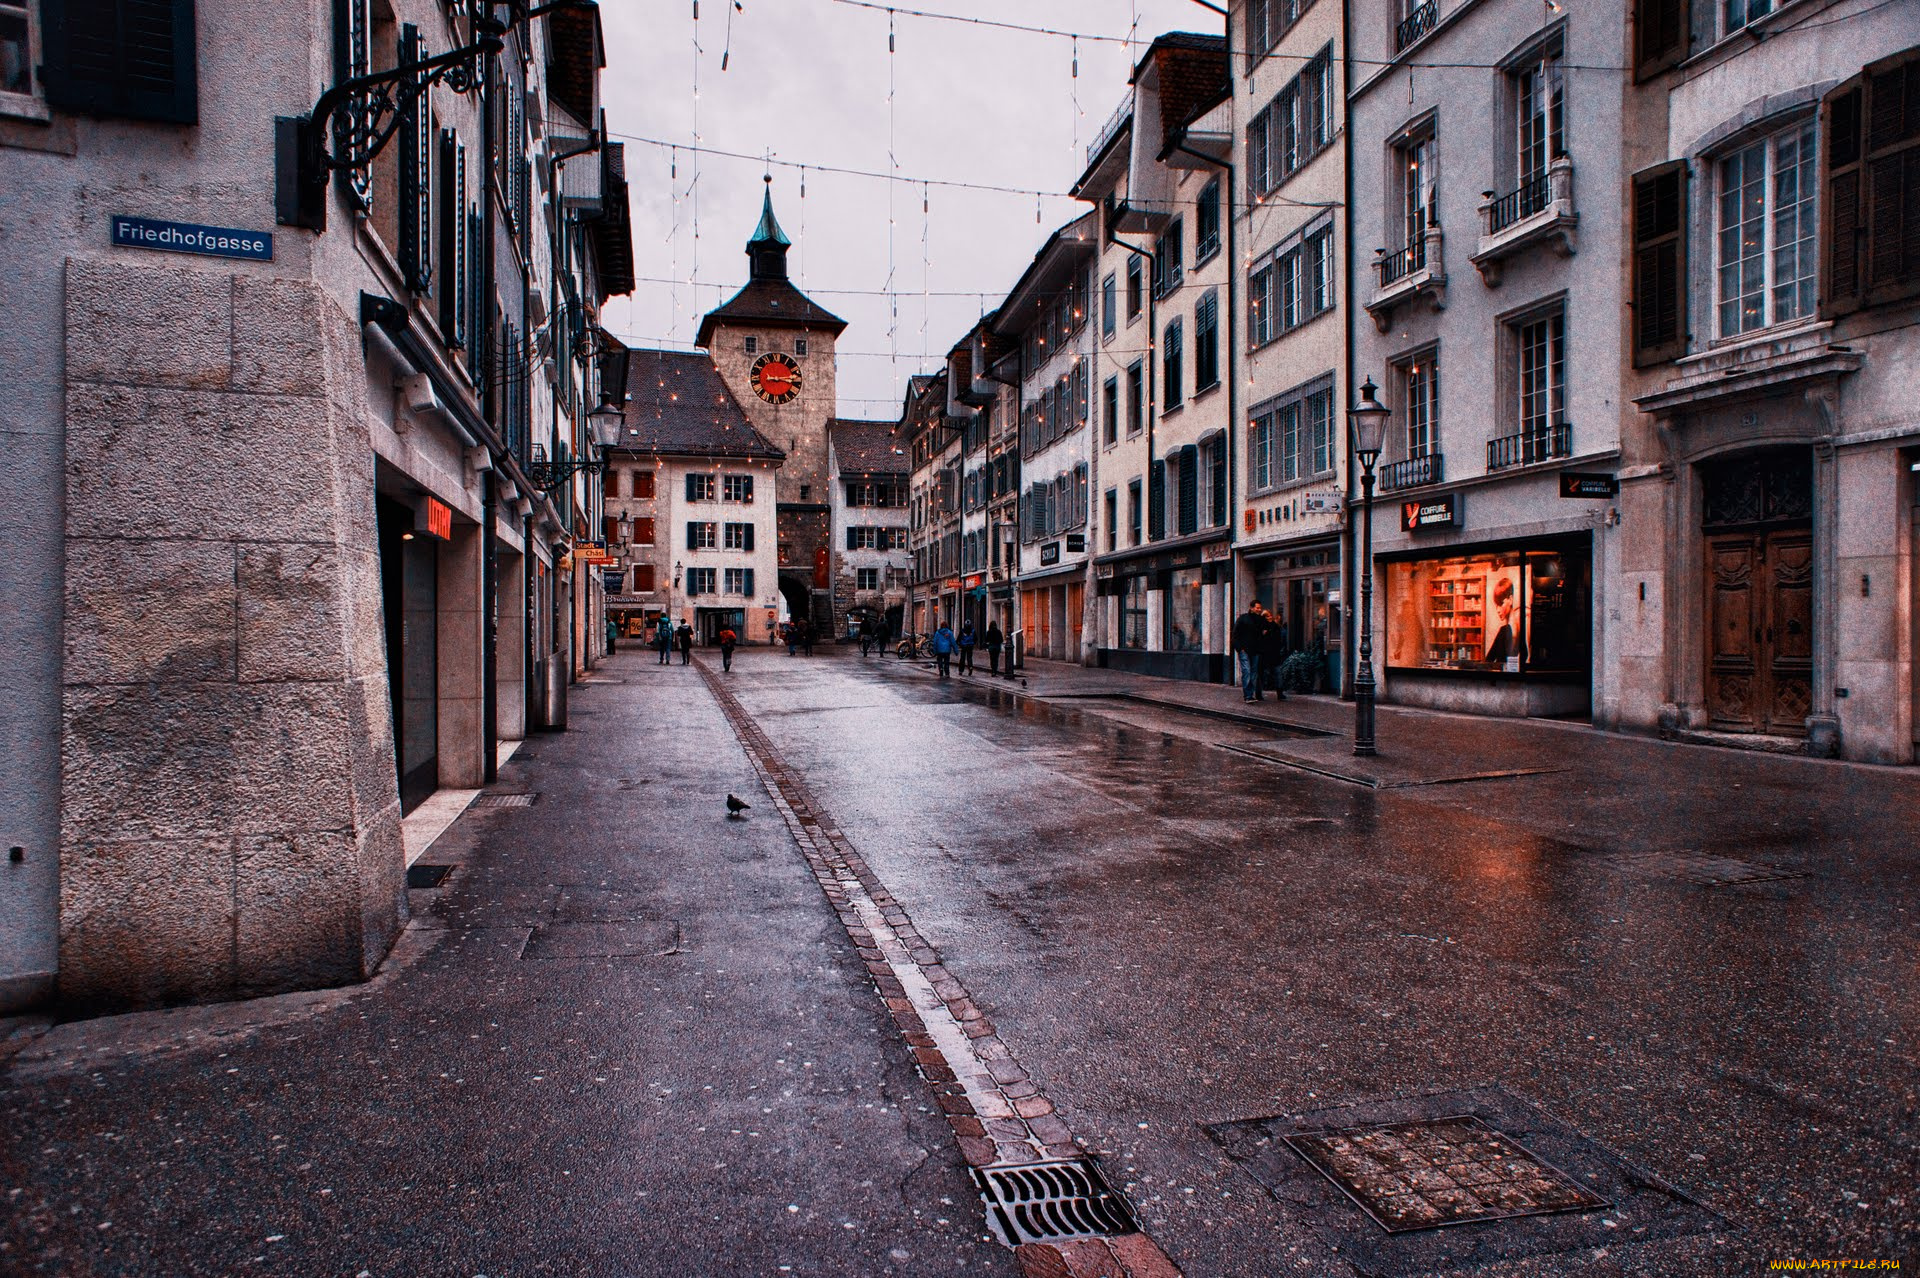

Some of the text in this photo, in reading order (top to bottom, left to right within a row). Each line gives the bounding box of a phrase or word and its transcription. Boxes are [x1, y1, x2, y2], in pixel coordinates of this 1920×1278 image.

[118, 222, 265, 252] Friedhofgasse
[1420, 503, 1447, 515] COIFFURE
[1420, 512, 1452, 524] VARIBELLE
